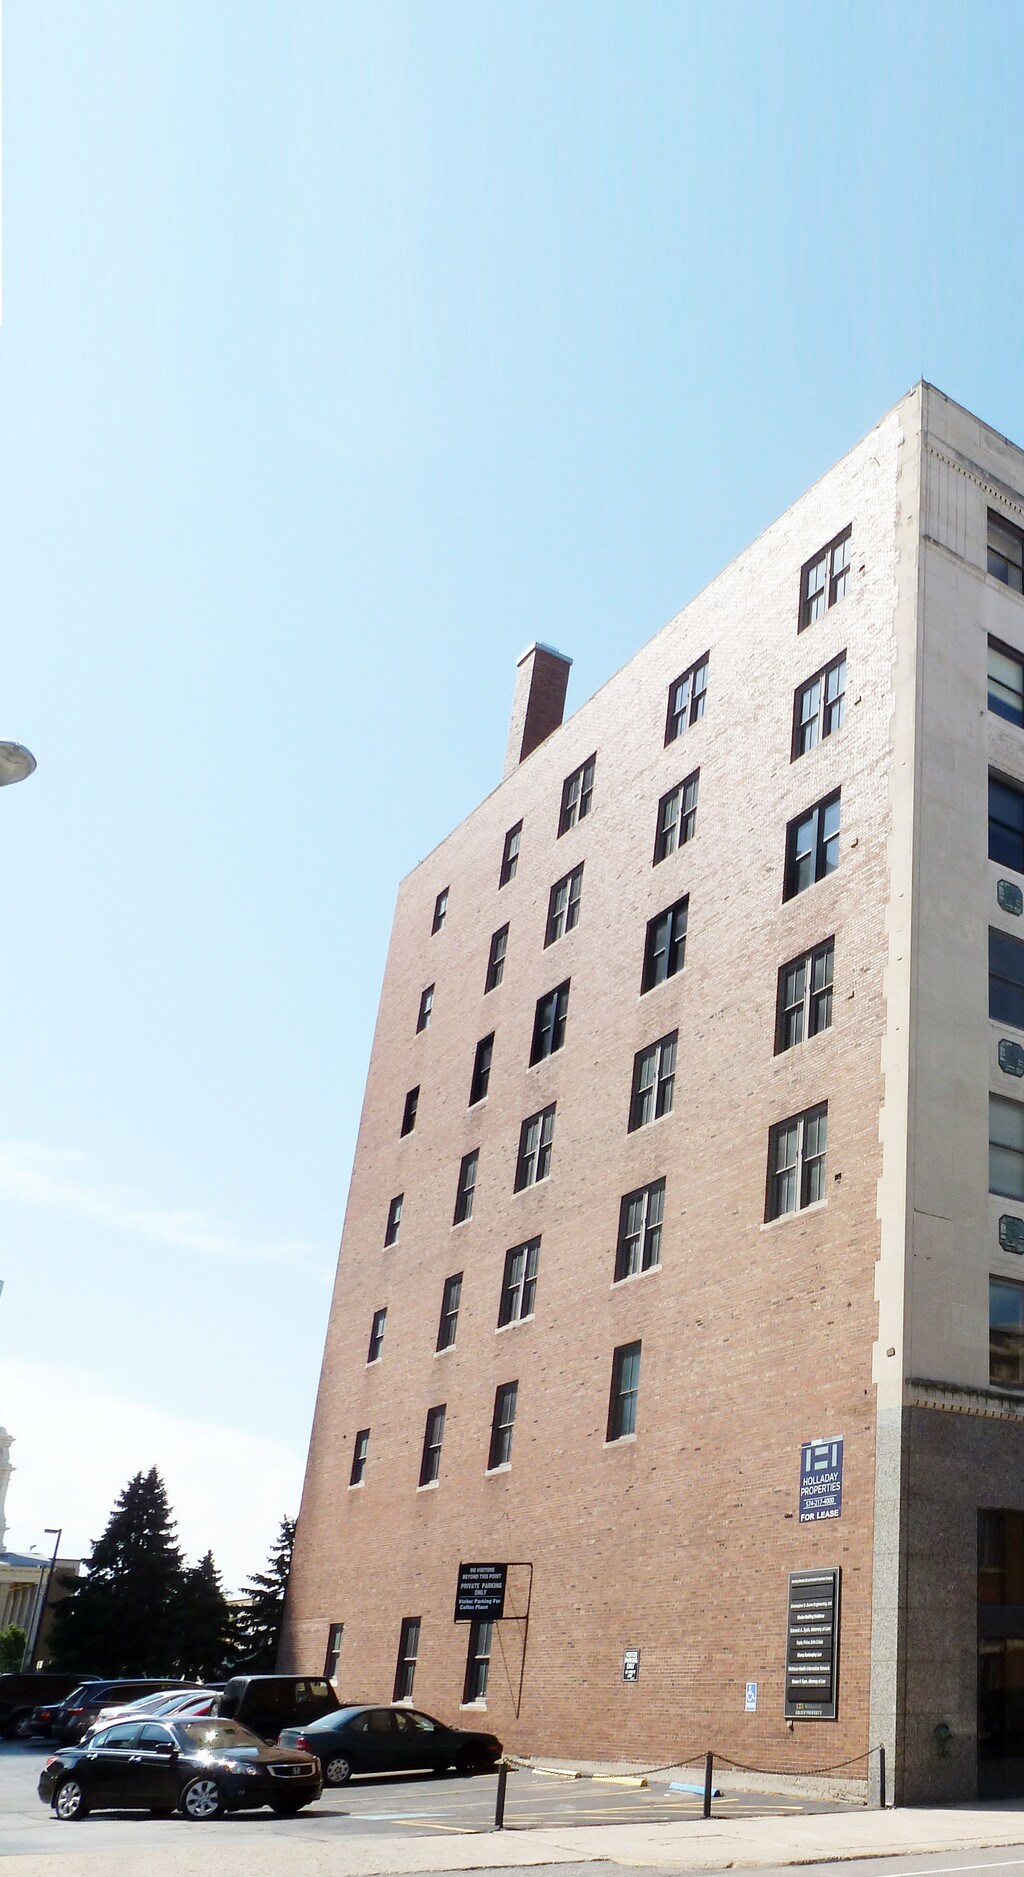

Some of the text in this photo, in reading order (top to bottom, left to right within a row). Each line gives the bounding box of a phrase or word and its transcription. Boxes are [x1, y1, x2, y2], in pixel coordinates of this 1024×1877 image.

[803, 1472, 839, 1486] HOLLADAY
[801, 1482, 840, 1496] PROPERTIES
[800, 1509, 839, 1522] FOR LEASE
